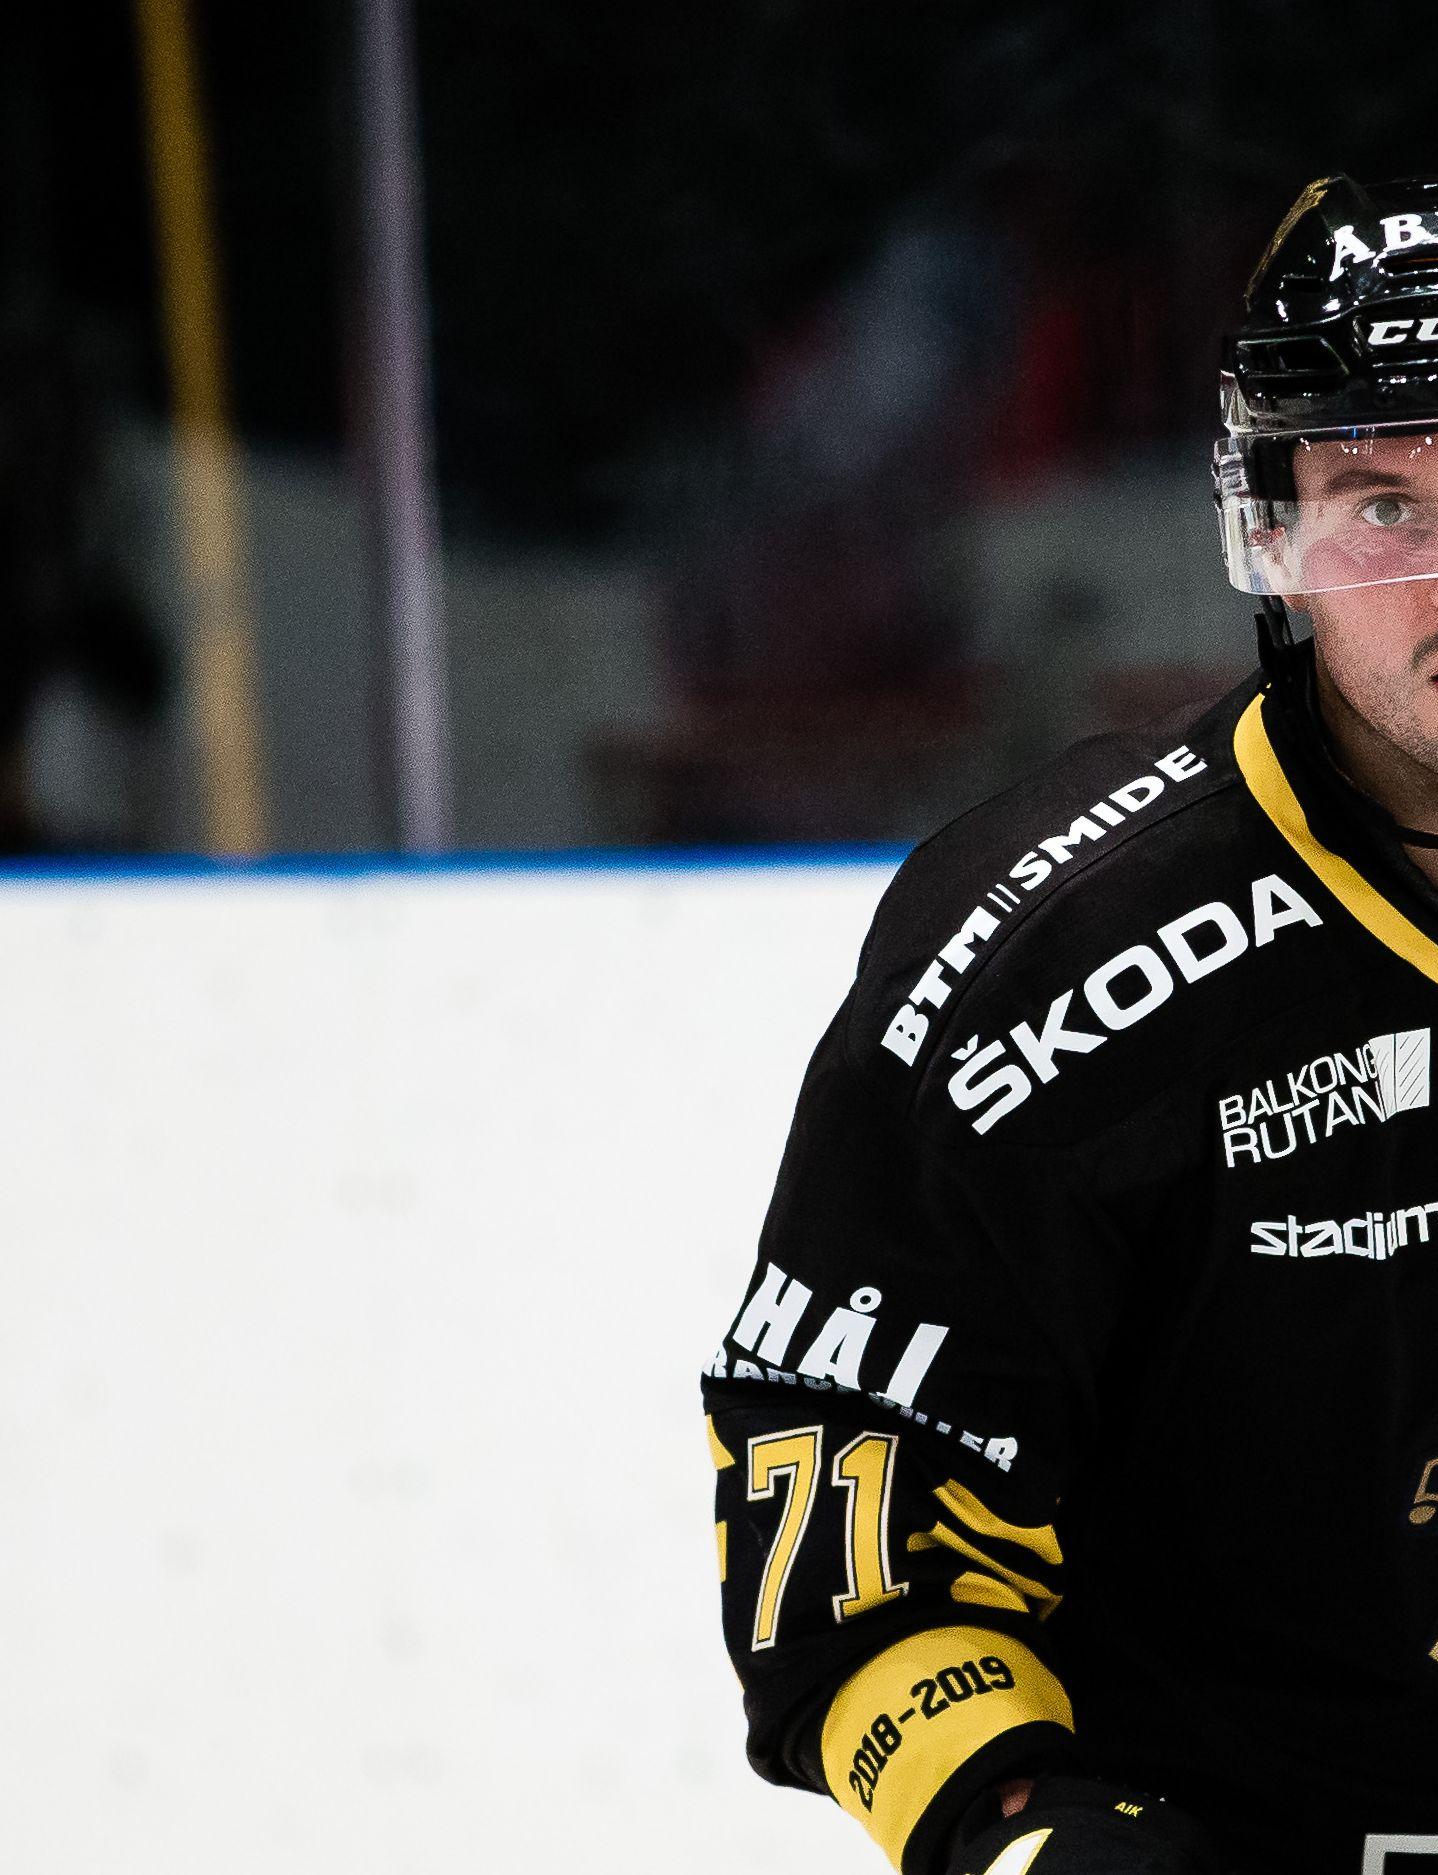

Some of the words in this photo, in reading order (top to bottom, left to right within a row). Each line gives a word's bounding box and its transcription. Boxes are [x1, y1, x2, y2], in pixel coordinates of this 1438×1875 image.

[881, 905, 1001, 1067] BTM
[1009, 745, 1208, 891] SMIDE
[947, 873, 1324, 1136] ŠKODA
[1218, 1043, 1378, 1131] BALKONG
[1223, 1080, 1388, 1168] RUTAN
[746, 1422, 910, 1654] 71
[847, 1655, 1017, 1814] 2018-2019
[1114, 1801, 1144, 1818] AIK
